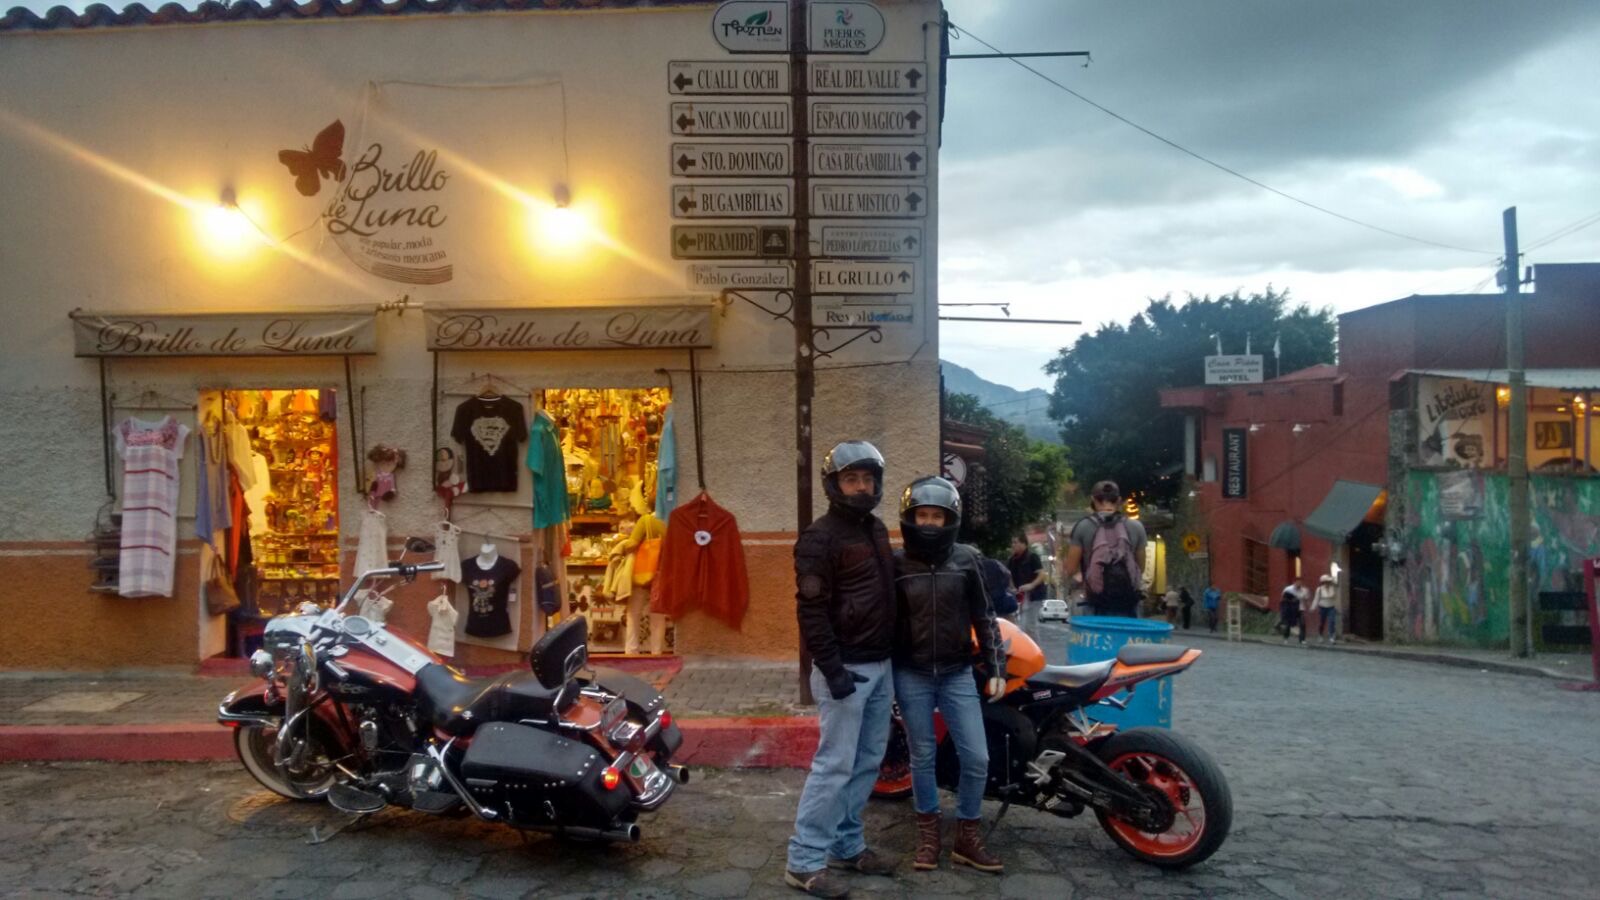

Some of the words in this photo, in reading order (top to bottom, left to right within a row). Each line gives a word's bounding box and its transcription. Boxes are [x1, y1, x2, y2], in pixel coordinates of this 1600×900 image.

[824, 29, 865, 38] PUEBLOS
[697, 69, 739, 90] CUALLI
[743, 69, 779, 90] COCHI
[815, 69, 843, 89] REAL
[845, 69, 866, 89] DEL
[867, 69, 901, 89] VALLE
[697, 111, 731, 130] NICAN
[734, 111, 751, 130] MO
[752, 111, 785, 130] CALLI
[816, 111, 860, 130] ESPACIO
[861, 111, 904, 130] MAGICO
[701, 151, 726, 171] STO.
[728, 151, 784, 171] DOMINGO
[818, 152, 843, 171] CASA
[844, 152, 903, 171] BUGAMBILIA
[341, 143, 451, 201] Brillo
[701, 193, 783, 212] BUGAMBILIAS
[822, 193, 854, 212] VALLE
[856, 193, 901, 212] MISTICO
[327, 199, 448, 237] Luna
[406, 235, 433, 250] moda
[696, 232, 756, 251] PIRAMIDE
[826, 239, 852, 252] PEDRO
[695, 272, 728, 285] Pablo
[730, 271, 785, 285] González
[818, 271, 835, 285] EL
[837, 271, 894, 286] GRULLO
[96, 320, 203, 353] Brillo
[210, 327, 246, 352] de
[256, 318, 357, 353] Luna
[435, 314, 546, 347] Brillo
[552, 320, 590, 346] de
[599, 311, 702, 347] Luna
[1228, 433, 1240, 495] RESTAURANT
